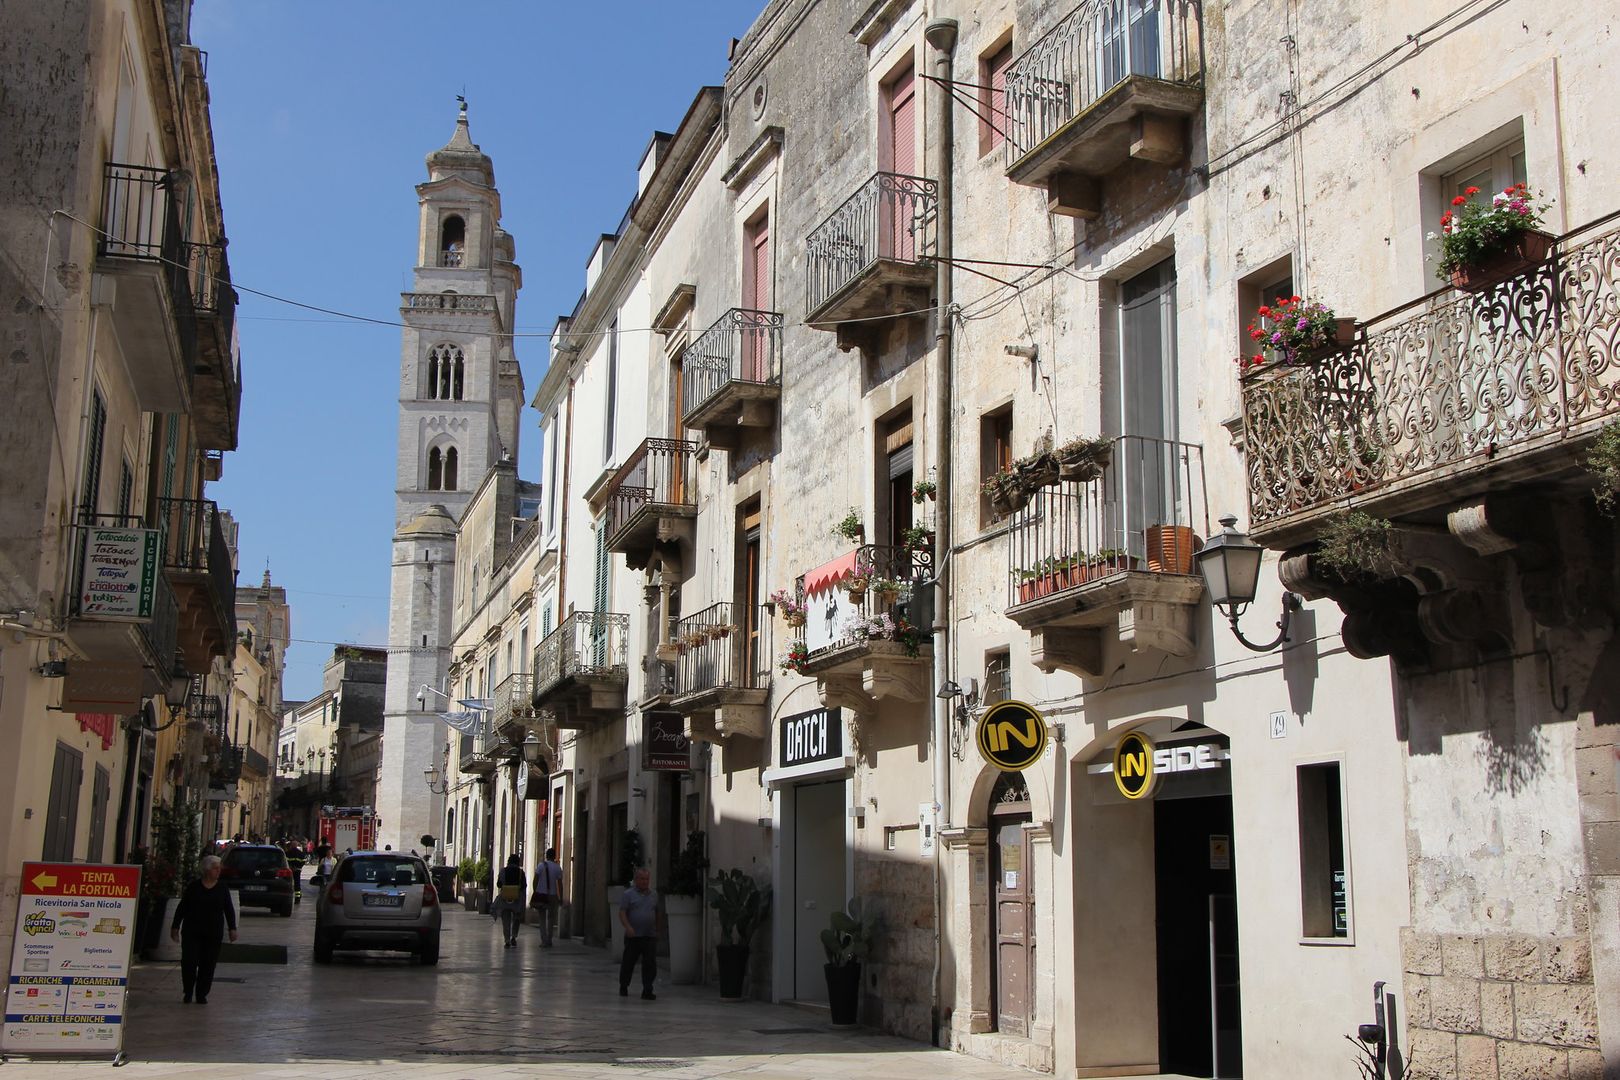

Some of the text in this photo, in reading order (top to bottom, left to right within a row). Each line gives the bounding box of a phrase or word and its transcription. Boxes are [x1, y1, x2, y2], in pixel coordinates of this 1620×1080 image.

[94, 531, 138, 542] Totocalcio
[96, 567, 128, 579] Totogol
[142, 532, 154, 616] RICEVITORIA
[89, 582, 129, 590] Enalotto
[786, 712, 828, 762] DATCH
[987, 718, 1038, 752] IN
[1121, 745, 1216, 778] IN SIDE
[82, 872, 115, 884] TENTA
[63, 884, 130, 896] LA FORTUNA
[35, 898, 78, 908] Ricevitoria
[96, 900, 122, 908] Nicola
[51, 1015, 105, 1023] TELEFONICHE
